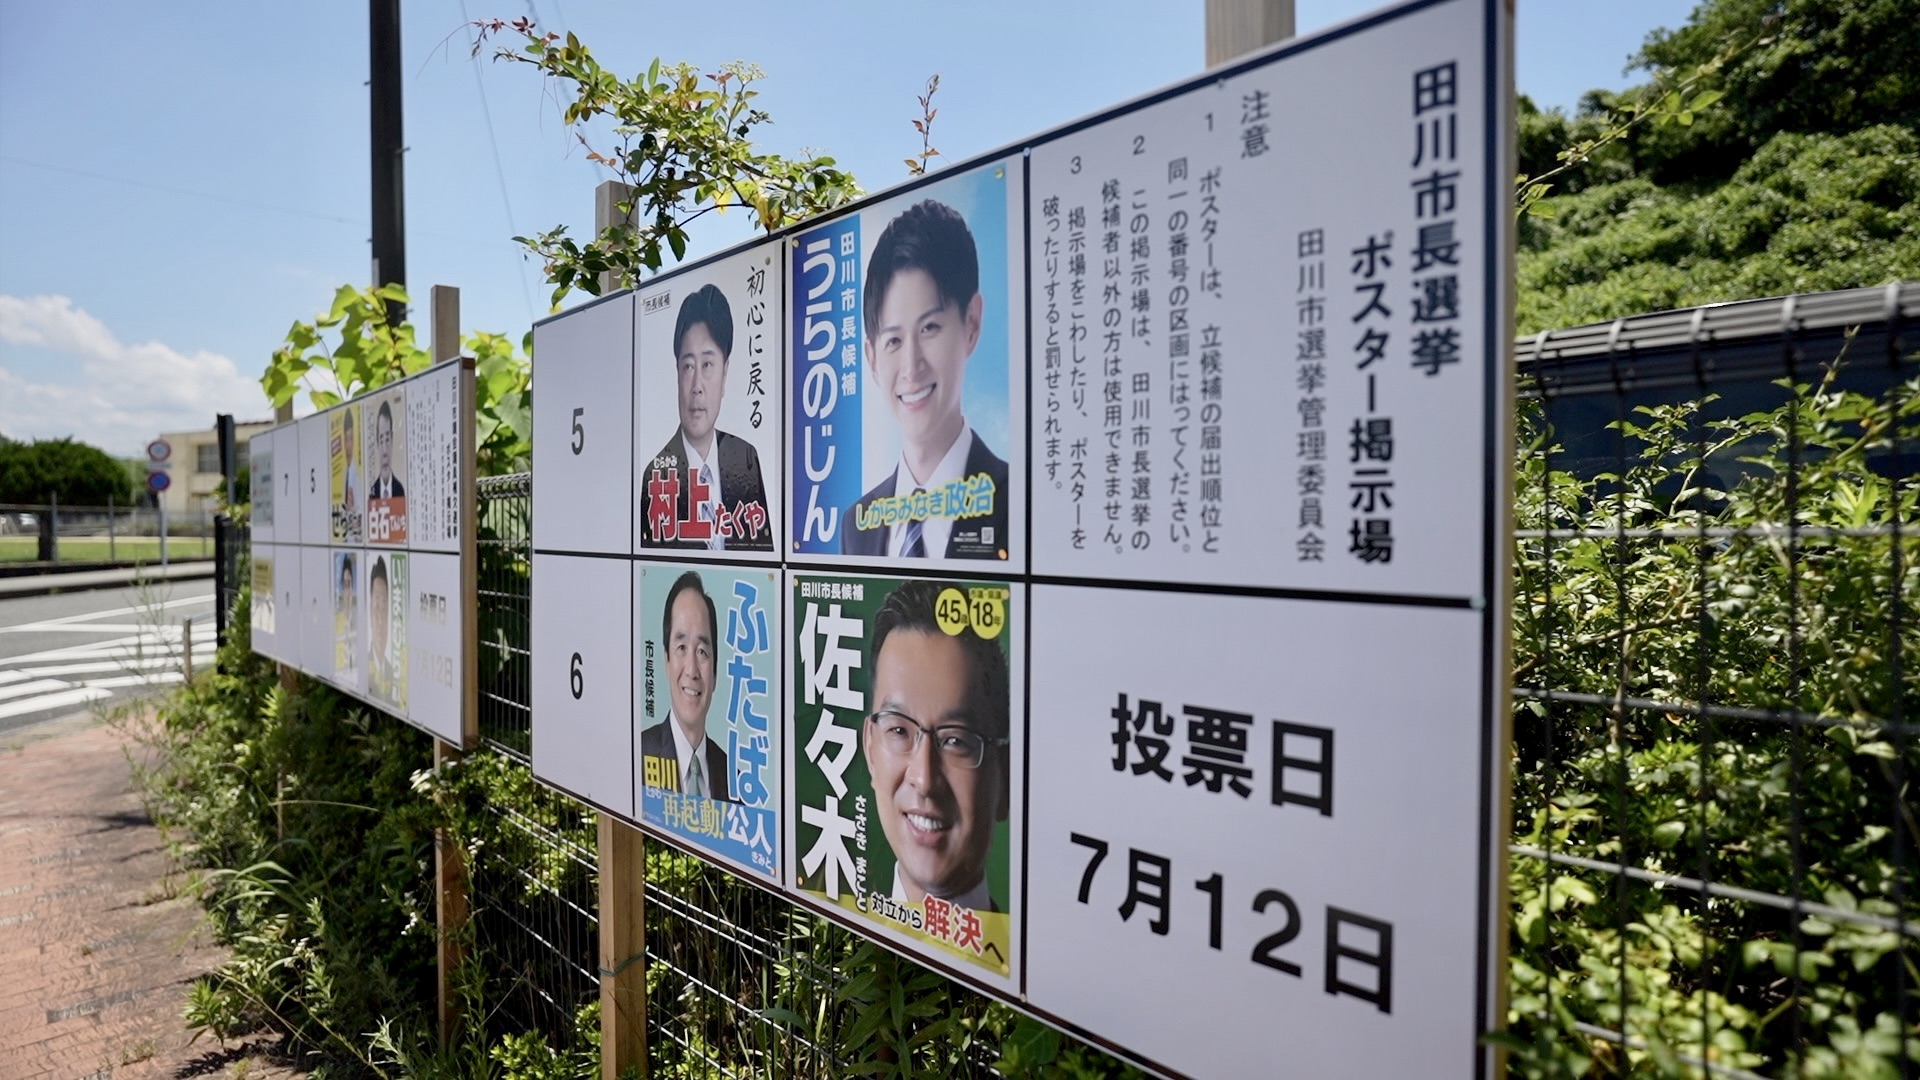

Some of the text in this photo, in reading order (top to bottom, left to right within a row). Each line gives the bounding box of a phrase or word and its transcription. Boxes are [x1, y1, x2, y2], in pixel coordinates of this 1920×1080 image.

[1070, 156, 1082, 175] 3
[1132, 135, 1145, 156] 2
[1204, 113, 1215, 132] 1
[1240, 89, 1271, 160] 注意
[1410, 59, 1463, 377] 田川市長選挙
[746, 266, 765, 429] 初心に戻る
[840, 230, 857, 396] 田川市長候補
[1042, 195, 1063, 489] 破ったりすると罰せられます。
[1101, 178, 1124, 554] 候補者以外の方は使用できません。
[1167, 157, 1191, 554] 同一の番号の区画にはってください。
[571, 407, 584, 455] 5
[802, 238, 838, 543] うらのじん
[1296, 228, 1327, 563] 田川市選挙管理委員会
[1349, 230, 1395, 564] ポスター掲示場
[856, 472, 996, 530] しがらみなき政治
[801, 582, 864, 601] 田川市長候補
[570, 652, 583, 700] 6
[645, 640, 654, 718] 市長候補
[725, 579, 769, 806] ふたば
[644, 755, 678, 796] 田川
[799, 602, 864, 901] 佐々木
[1111, 692, 1335, 818] 投票日
[663, 791, 728, 840] 再起動!
[727, 803, 773, 856] 公人
[751, 851, 771, 869] きみと
[855, 795, 868, 913] ささき まこと
[1070, 831, 1393, 1016] 7月12日
